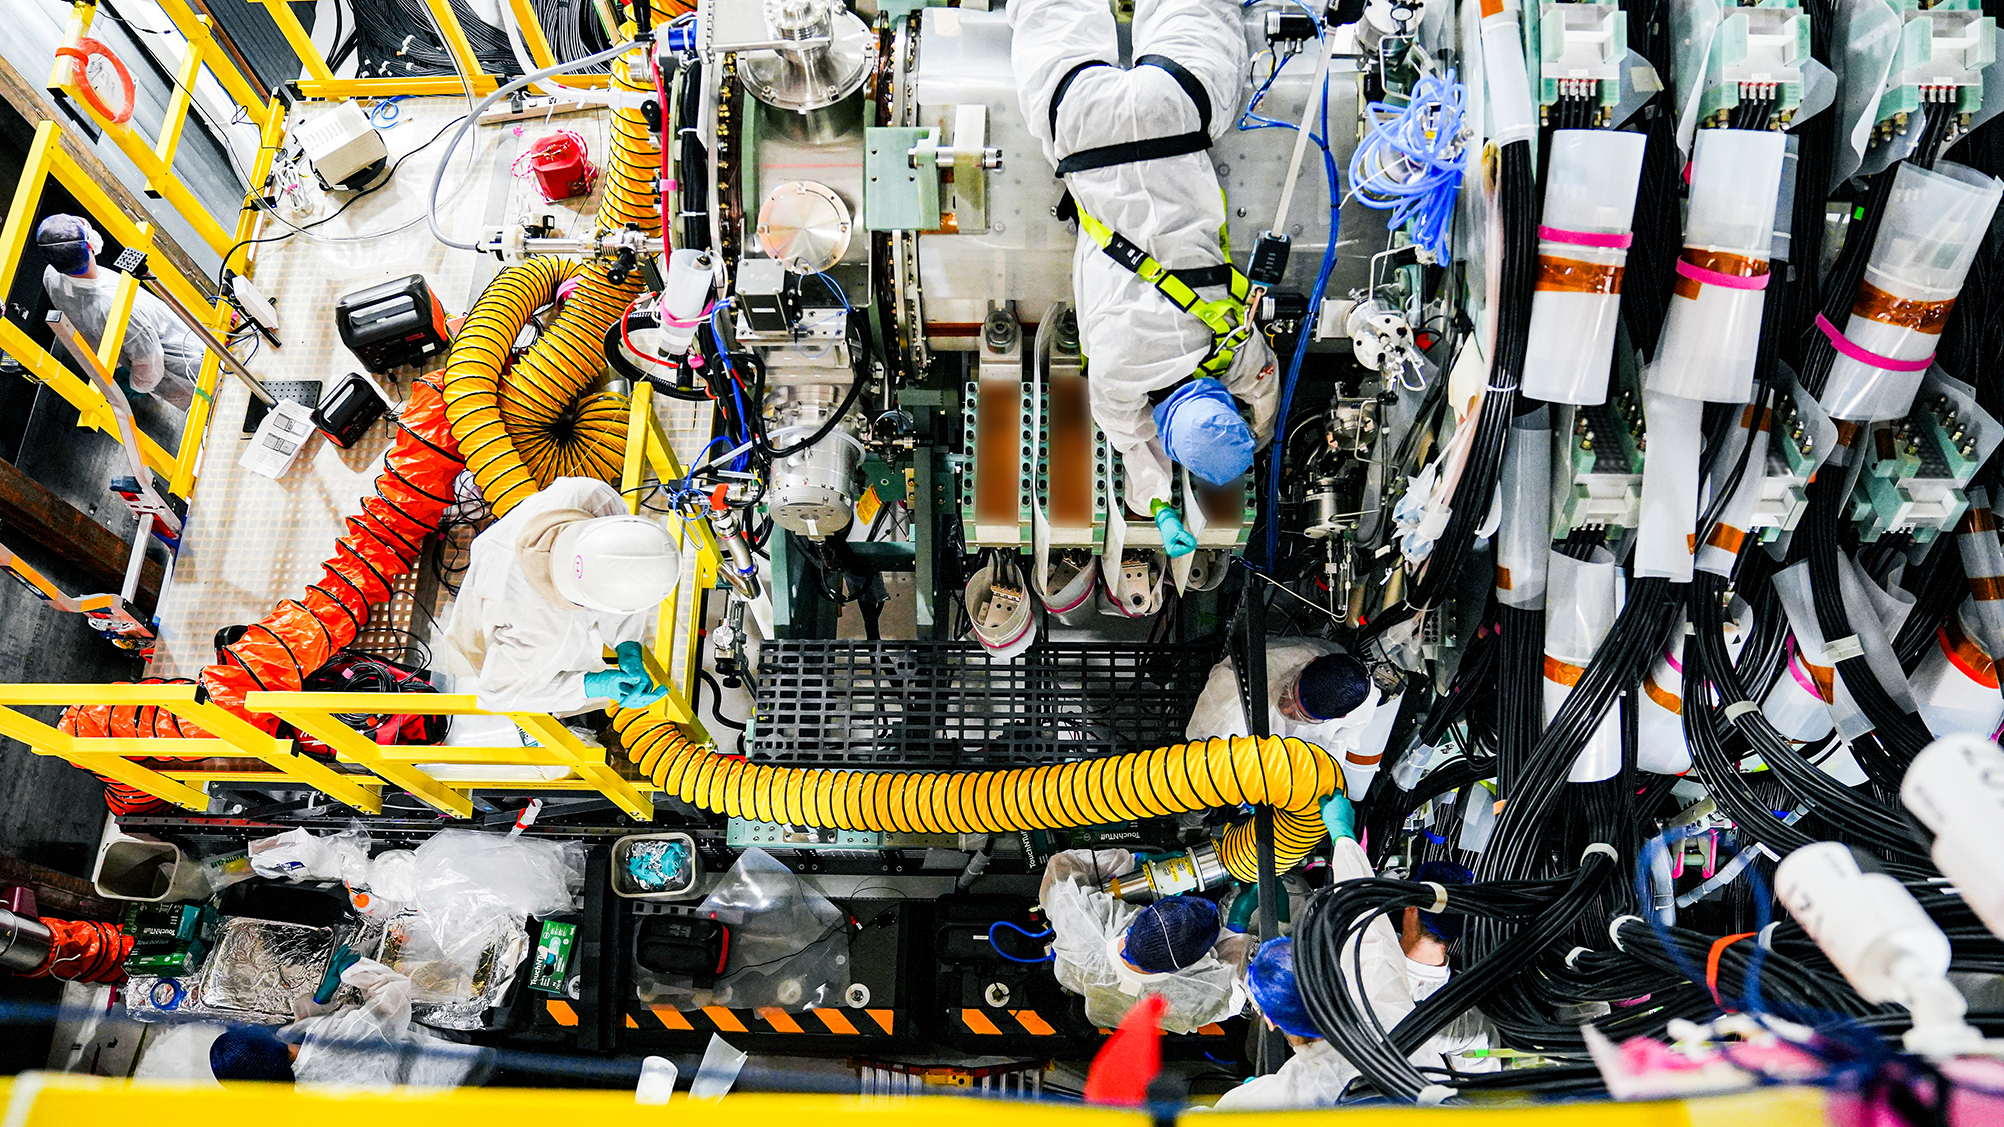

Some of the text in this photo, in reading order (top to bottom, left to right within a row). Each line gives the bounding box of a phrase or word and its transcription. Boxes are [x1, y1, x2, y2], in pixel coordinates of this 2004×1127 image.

[1020, 830, 1036, 869] TouchNTuf
[1100, 832, 1140, 840] TouchNTuff
[530, 953, 543, 986] TouchNT
